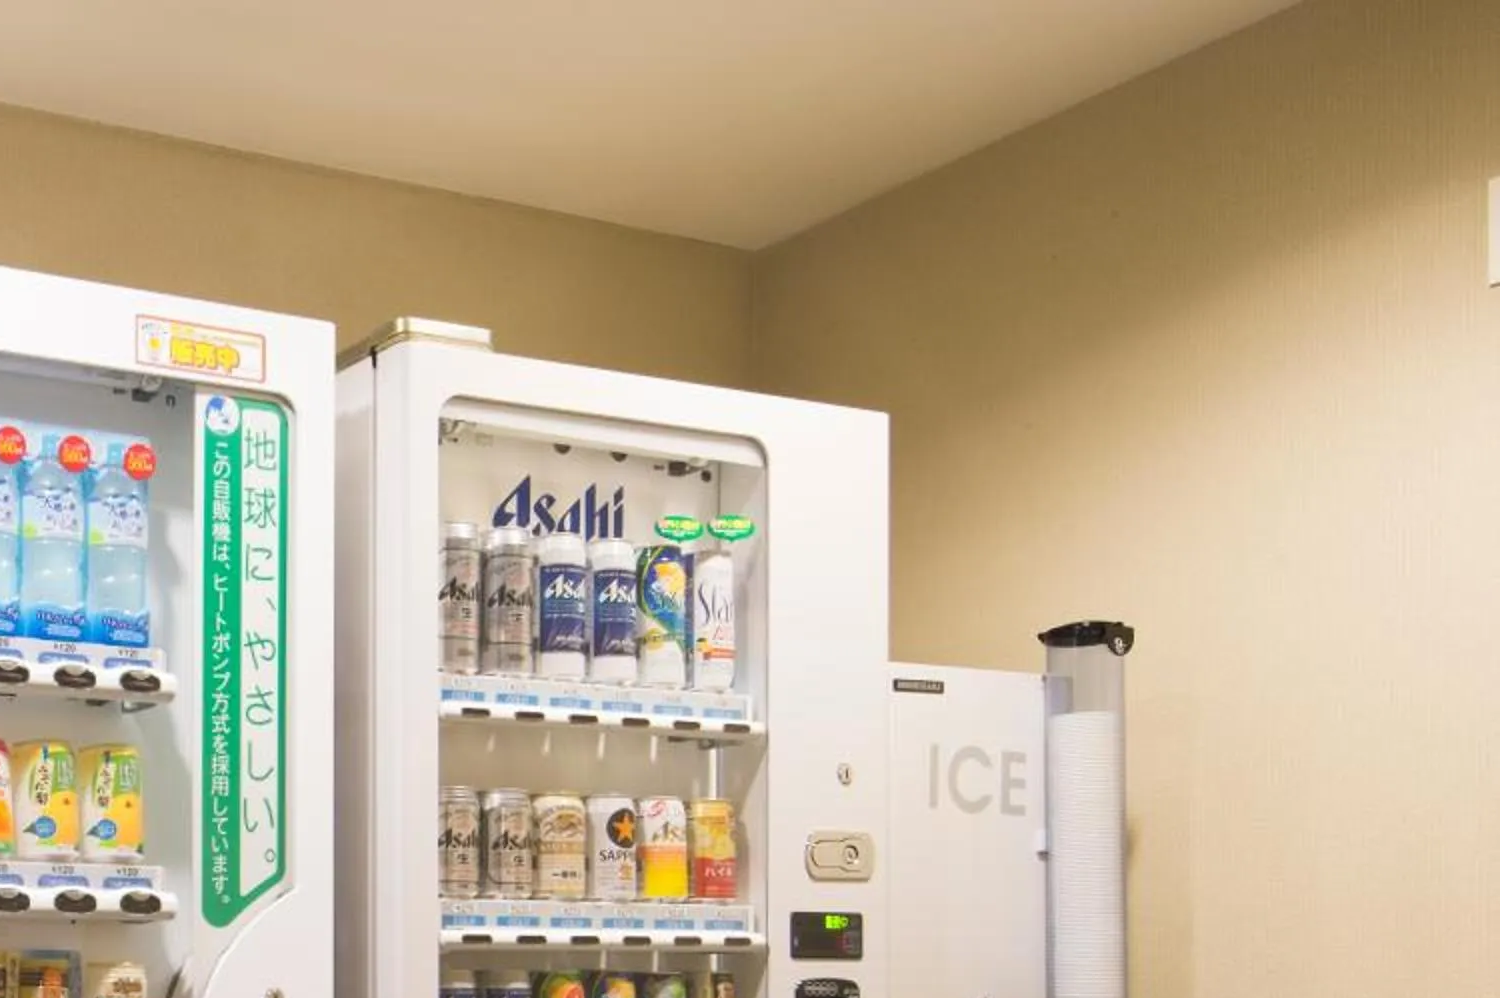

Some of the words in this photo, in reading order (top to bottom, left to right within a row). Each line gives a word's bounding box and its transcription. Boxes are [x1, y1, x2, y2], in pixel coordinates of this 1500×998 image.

[491, 473, 626, 544] Asahi
[243, 428, 278, 864] 地球に、やさしい。
[927, 743, 1027, 817] ICE
